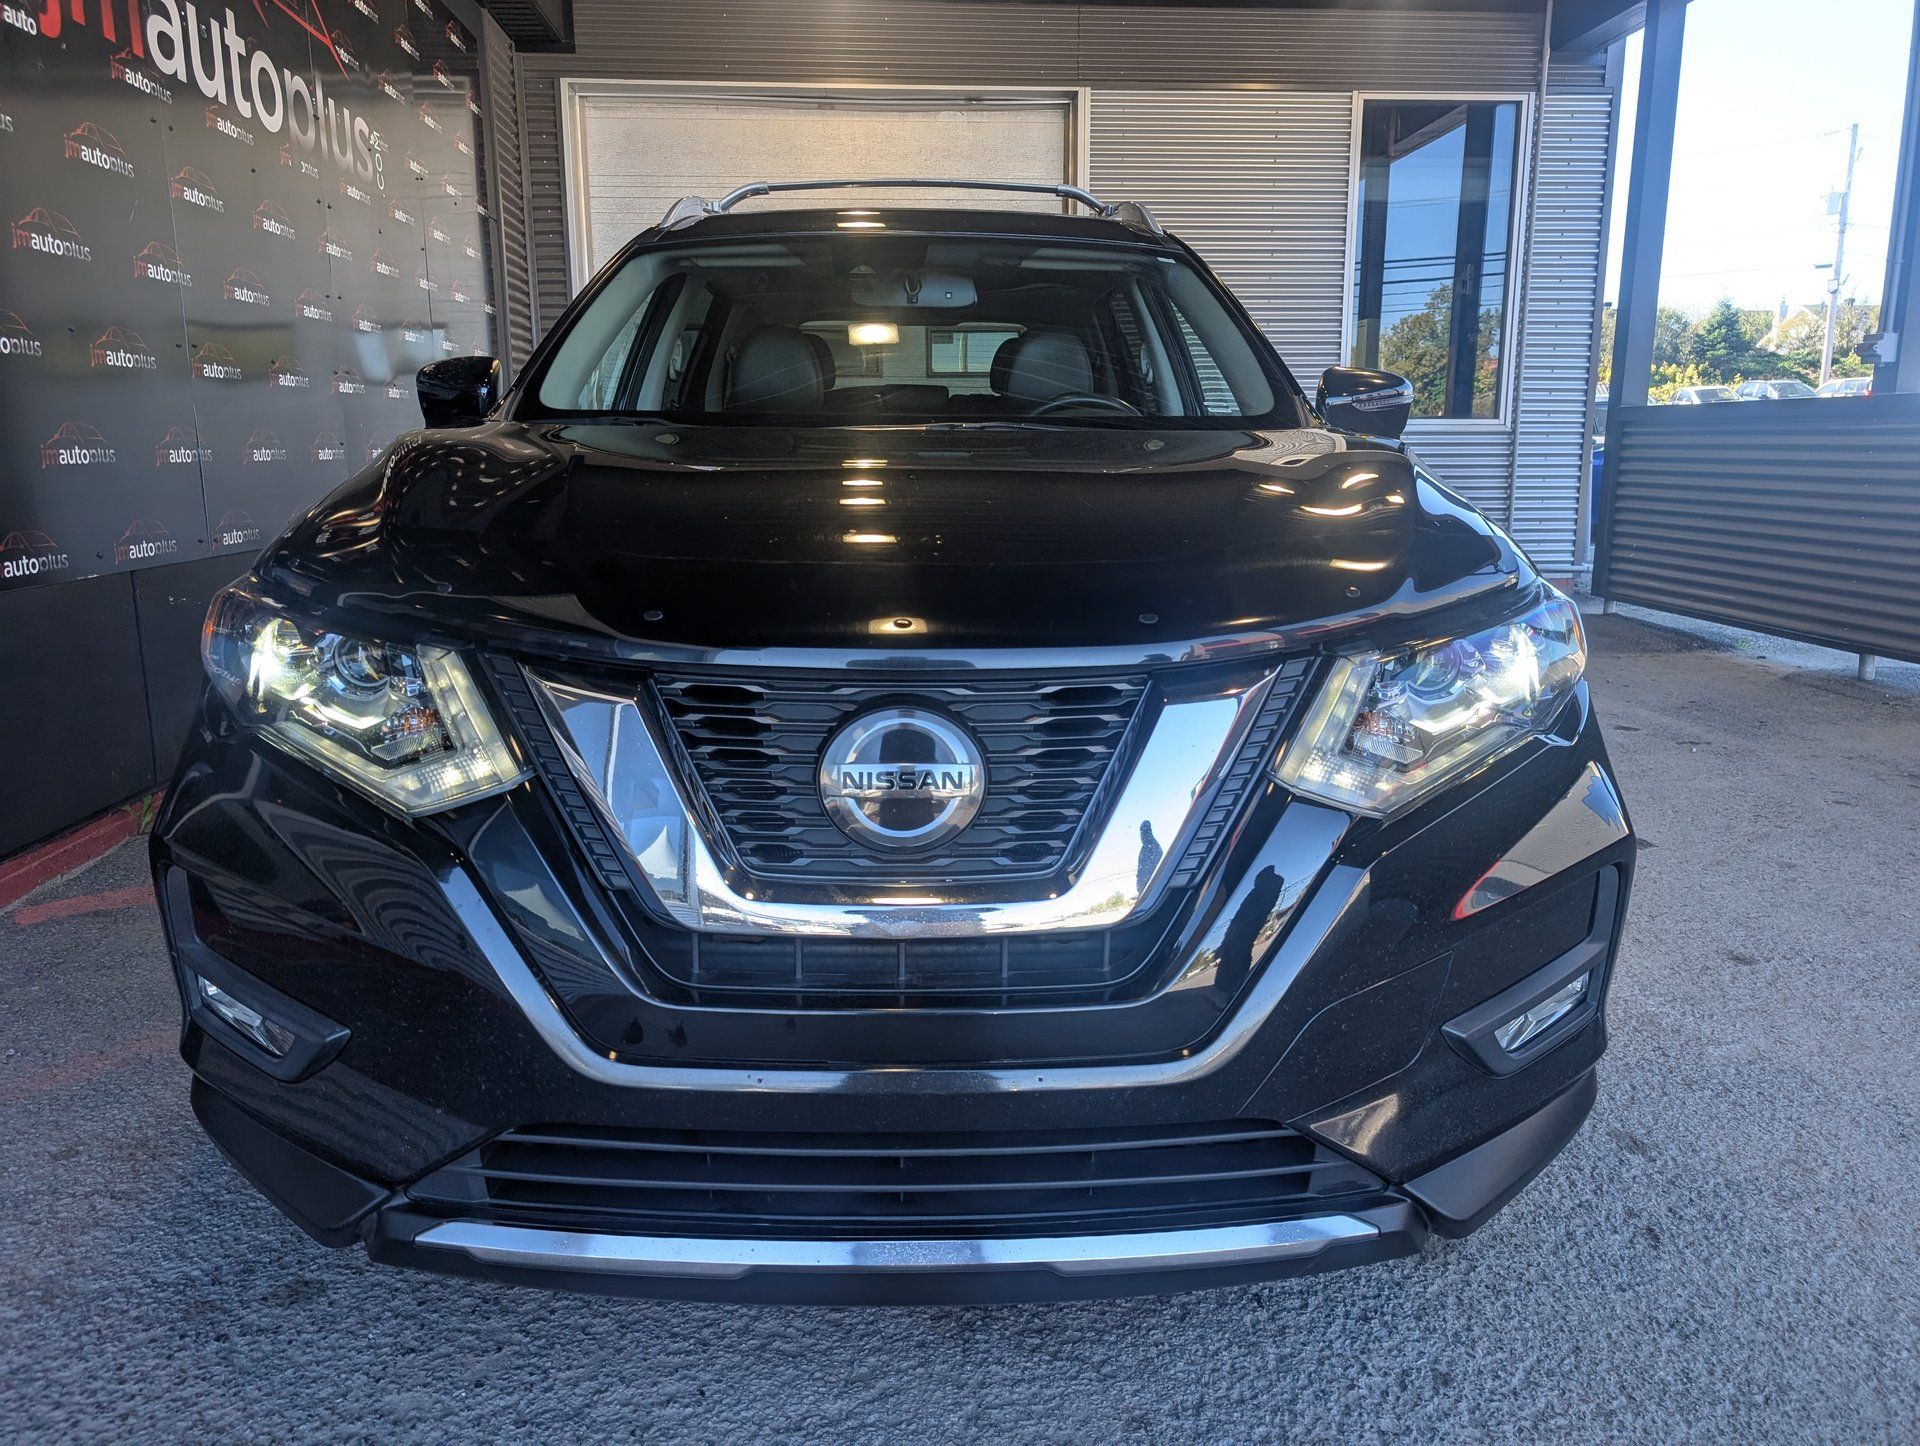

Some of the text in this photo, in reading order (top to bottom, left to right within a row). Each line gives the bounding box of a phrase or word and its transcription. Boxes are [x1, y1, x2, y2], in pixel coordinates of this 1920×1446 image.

[64, 133, 135, 178] jmautoplus
[11, 222, 91, 262] jmautoplus
[132, 255, 192, 287] jmautoplus
[90, 344, 156, 370] jmautoplus
[41, 445, 116, 469] jmautoplus
[113, 539, 177, 565] jmautoplus
[842, 771, 963, 790] NISSAN
